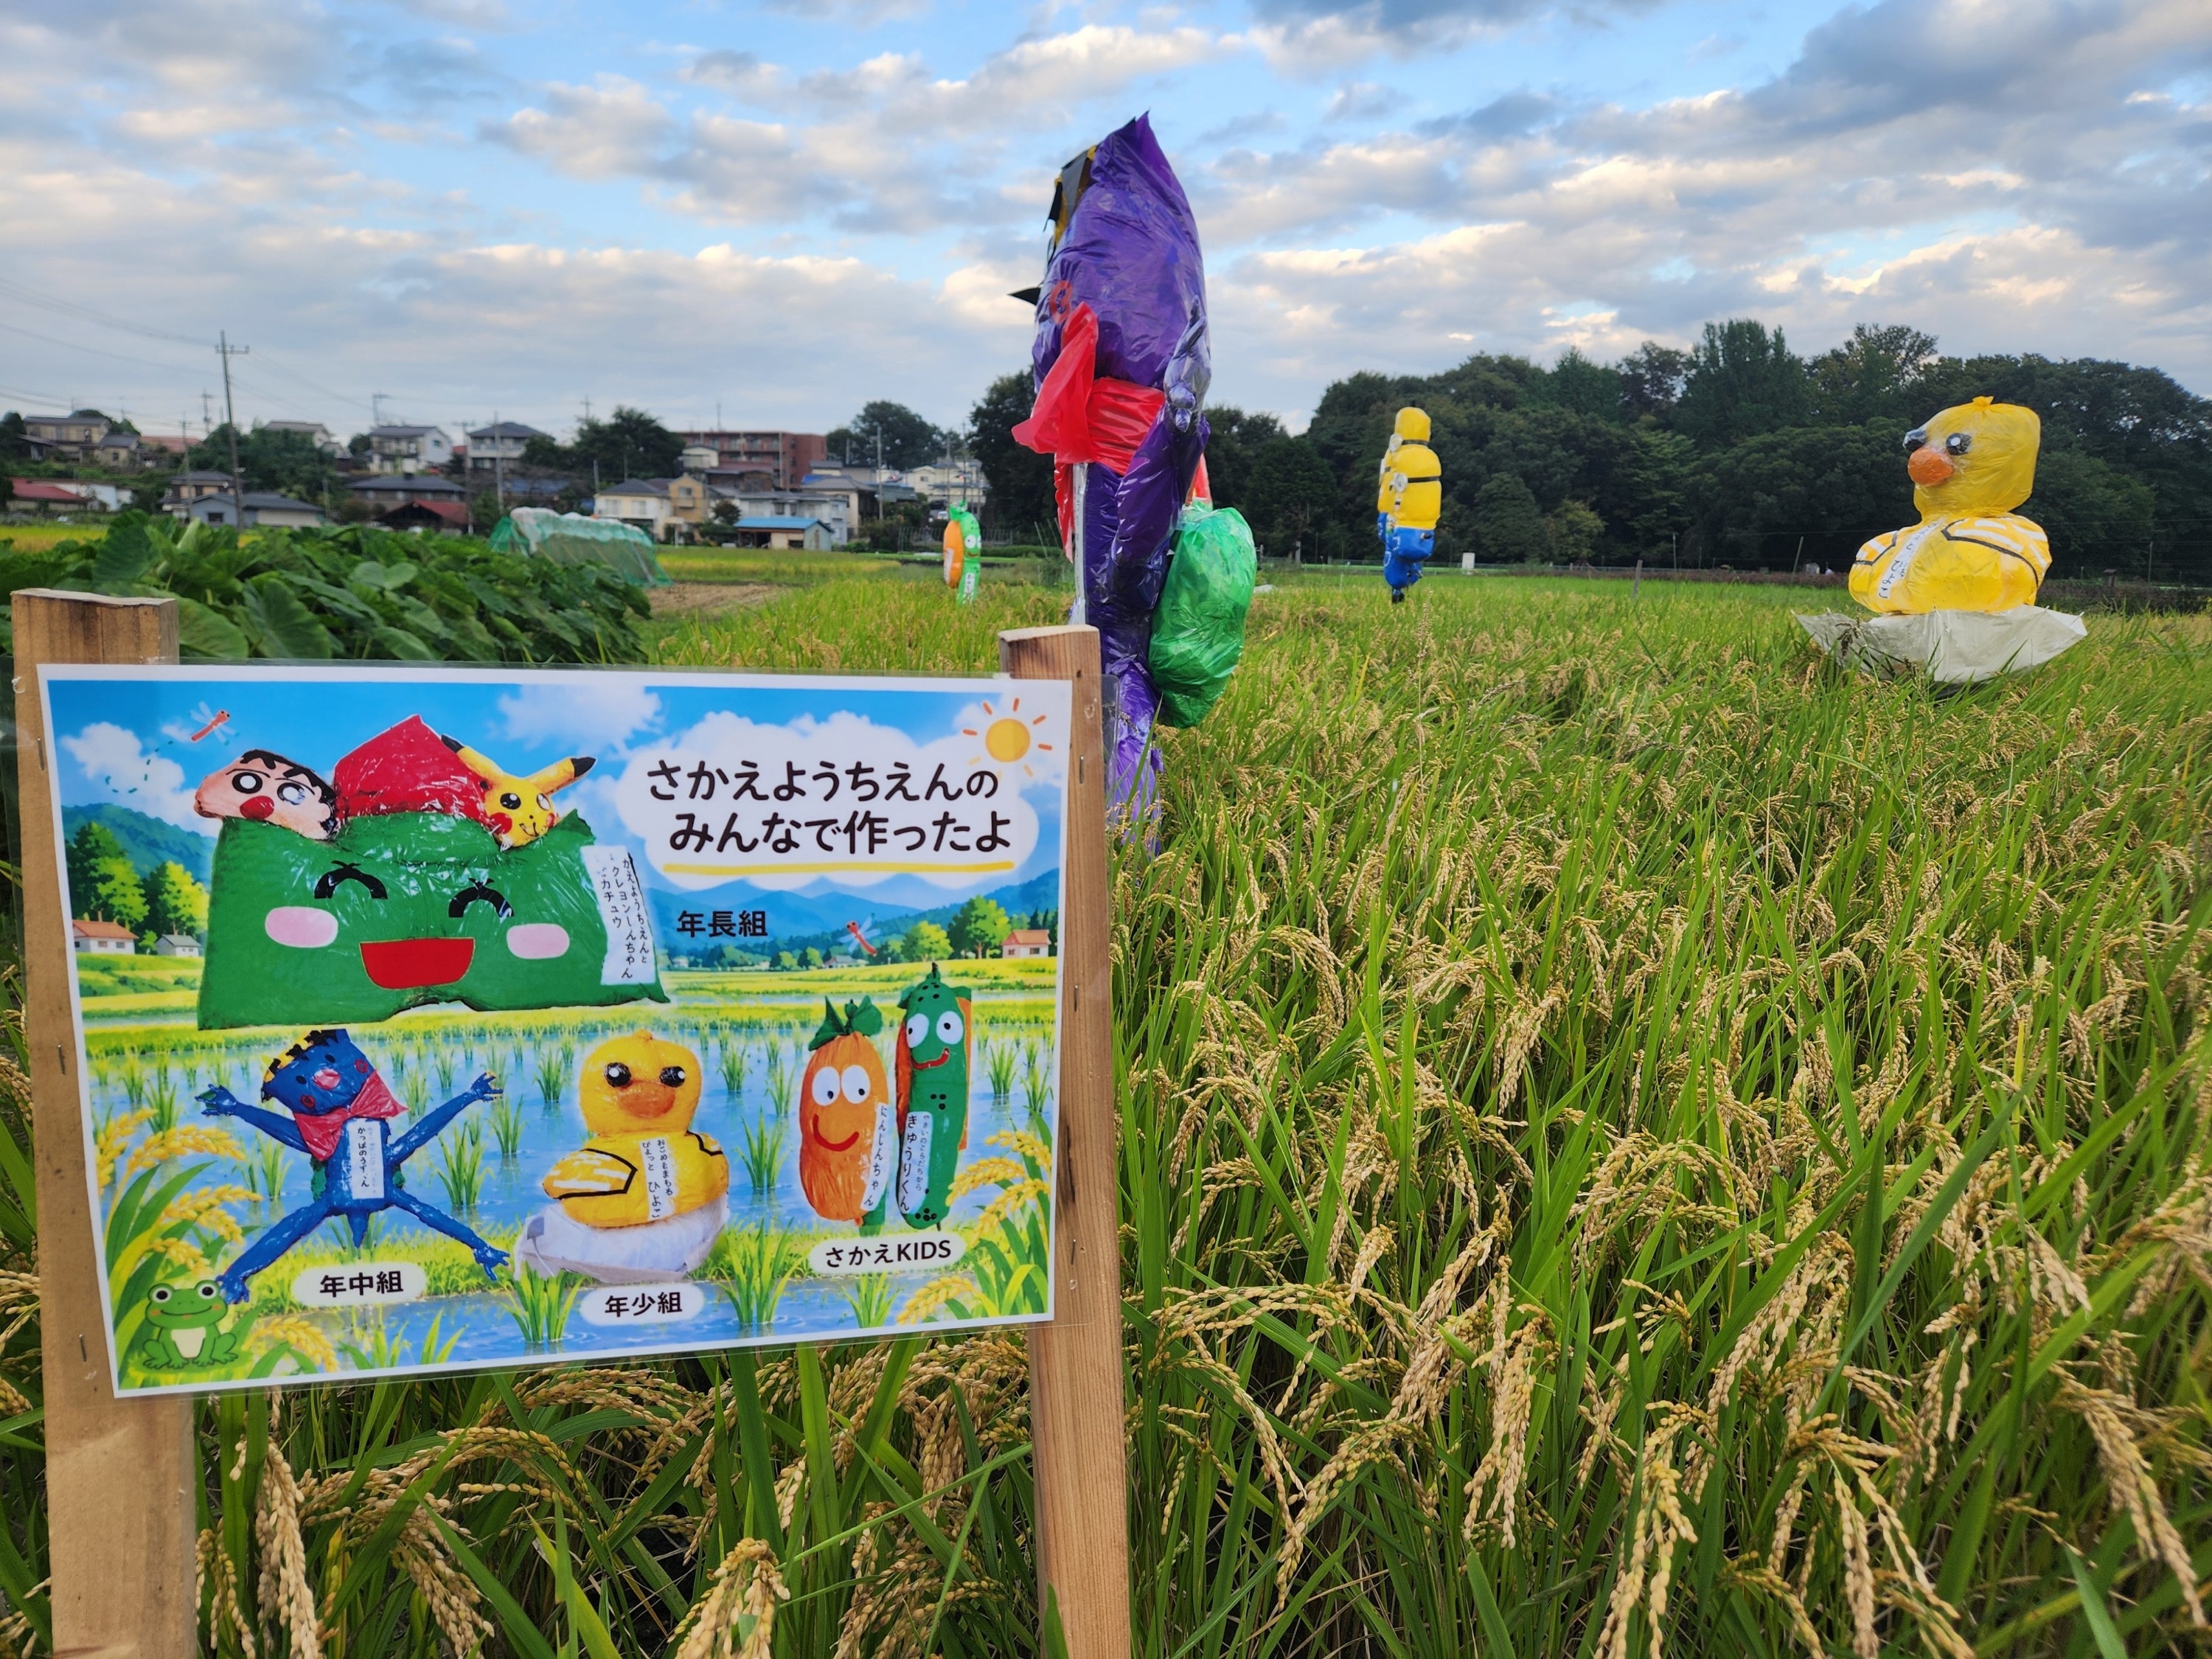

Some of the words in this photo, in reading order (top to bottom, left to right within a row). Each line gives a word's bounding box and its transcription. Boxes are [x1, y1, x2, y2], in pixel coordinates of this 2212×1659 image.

[647, 759, 998, 801] さかえようちえんの
[669, 810, 1011, 855] みんなで作ったよ
[676, 910, 768, 938] 年長組
[863, 1105, 888, 1207] にんじんちゃん
[900, 1115, 917, 1211] きゅうりくん
[826, 1239, 951, 1268] さかえKIDS
[319, 1270, 404, 1298] 年中組
[605, 1292, 683, 1318] 年少組
